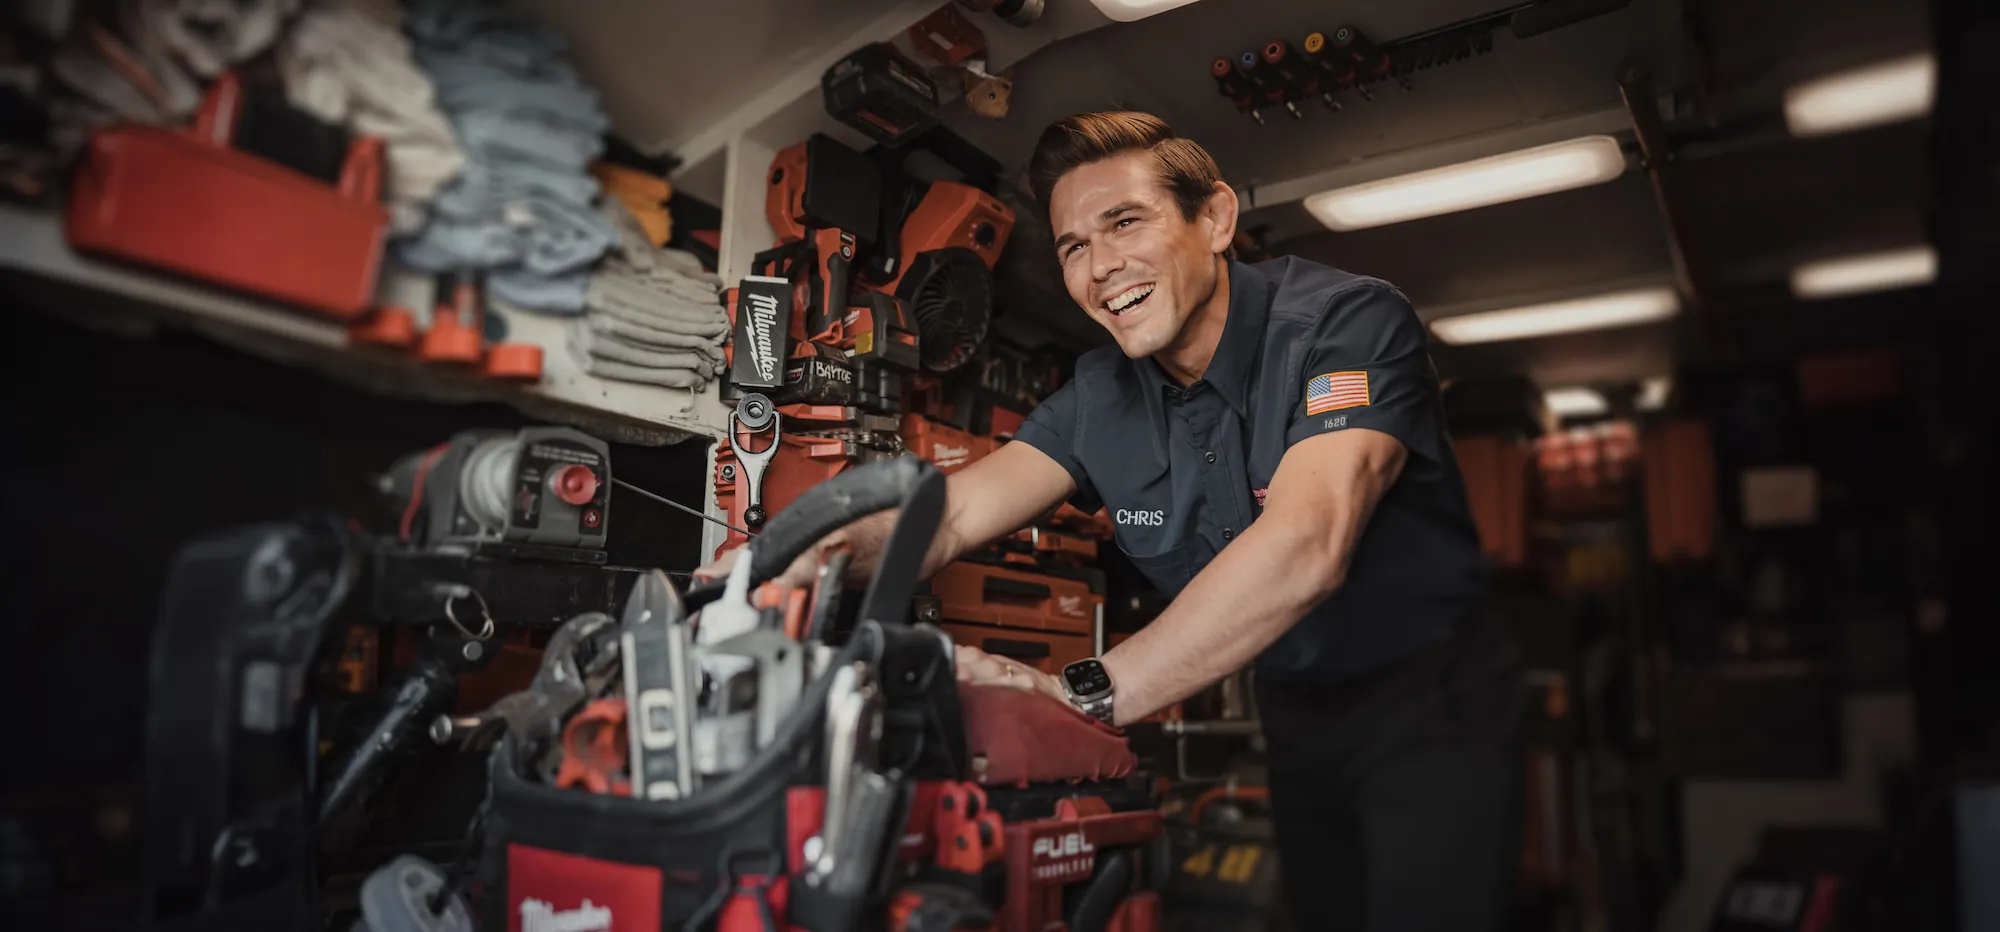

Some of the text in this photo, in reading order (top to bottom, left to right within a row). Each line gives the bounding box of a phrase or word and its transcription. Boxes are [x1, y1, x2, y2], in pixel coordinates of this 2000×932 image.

[748, 293, 779, 382] Milwaukee
[815, 361, 852, 384] BAYTOE
[1324, 416, 1346, 429] 1620
[1116, 509, 1164, 526] CHRIS
[1033, 834, 1093, 859] FUEL
